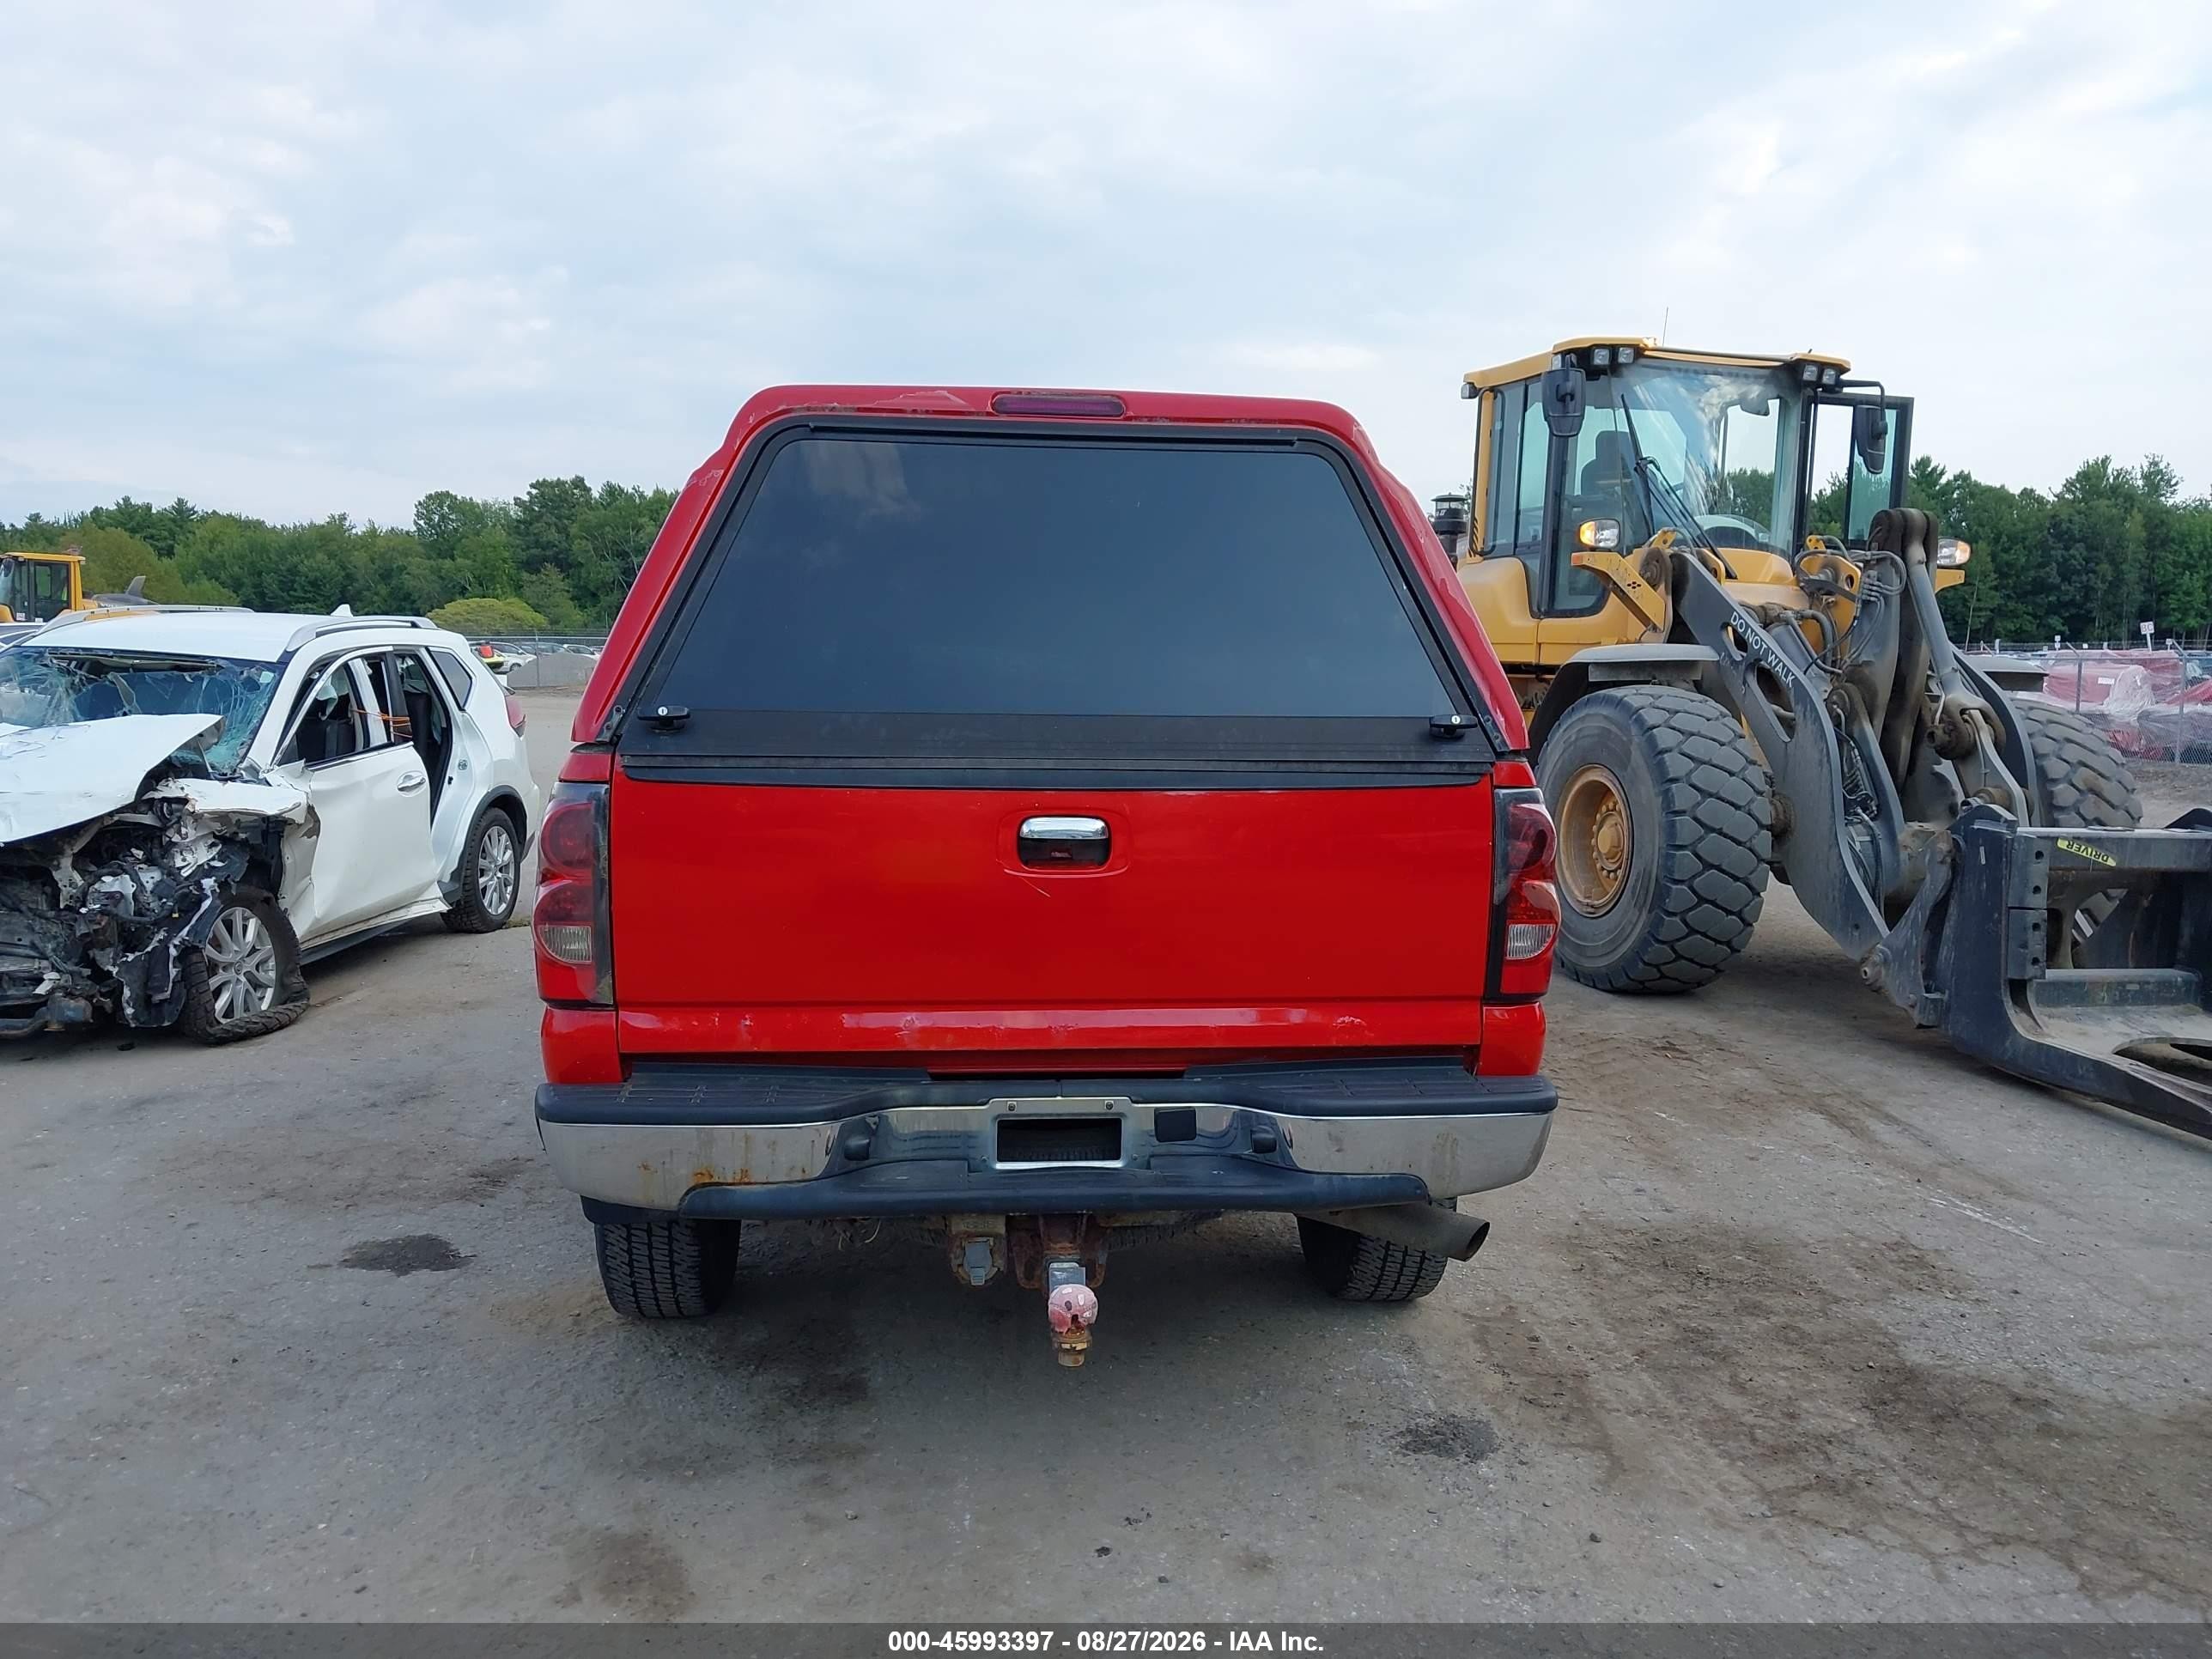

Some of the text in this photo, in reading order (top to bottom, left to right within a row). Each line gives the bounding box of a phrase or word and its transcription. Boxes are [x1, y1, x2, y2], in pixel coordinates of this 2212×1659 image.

[1730, 611, 1746, 633] DO
[1745, 628, 1768, 655] NOT
[1766, 649, 1796, 688] WALK
[2066, 840, 2110, 863] DRIVER
